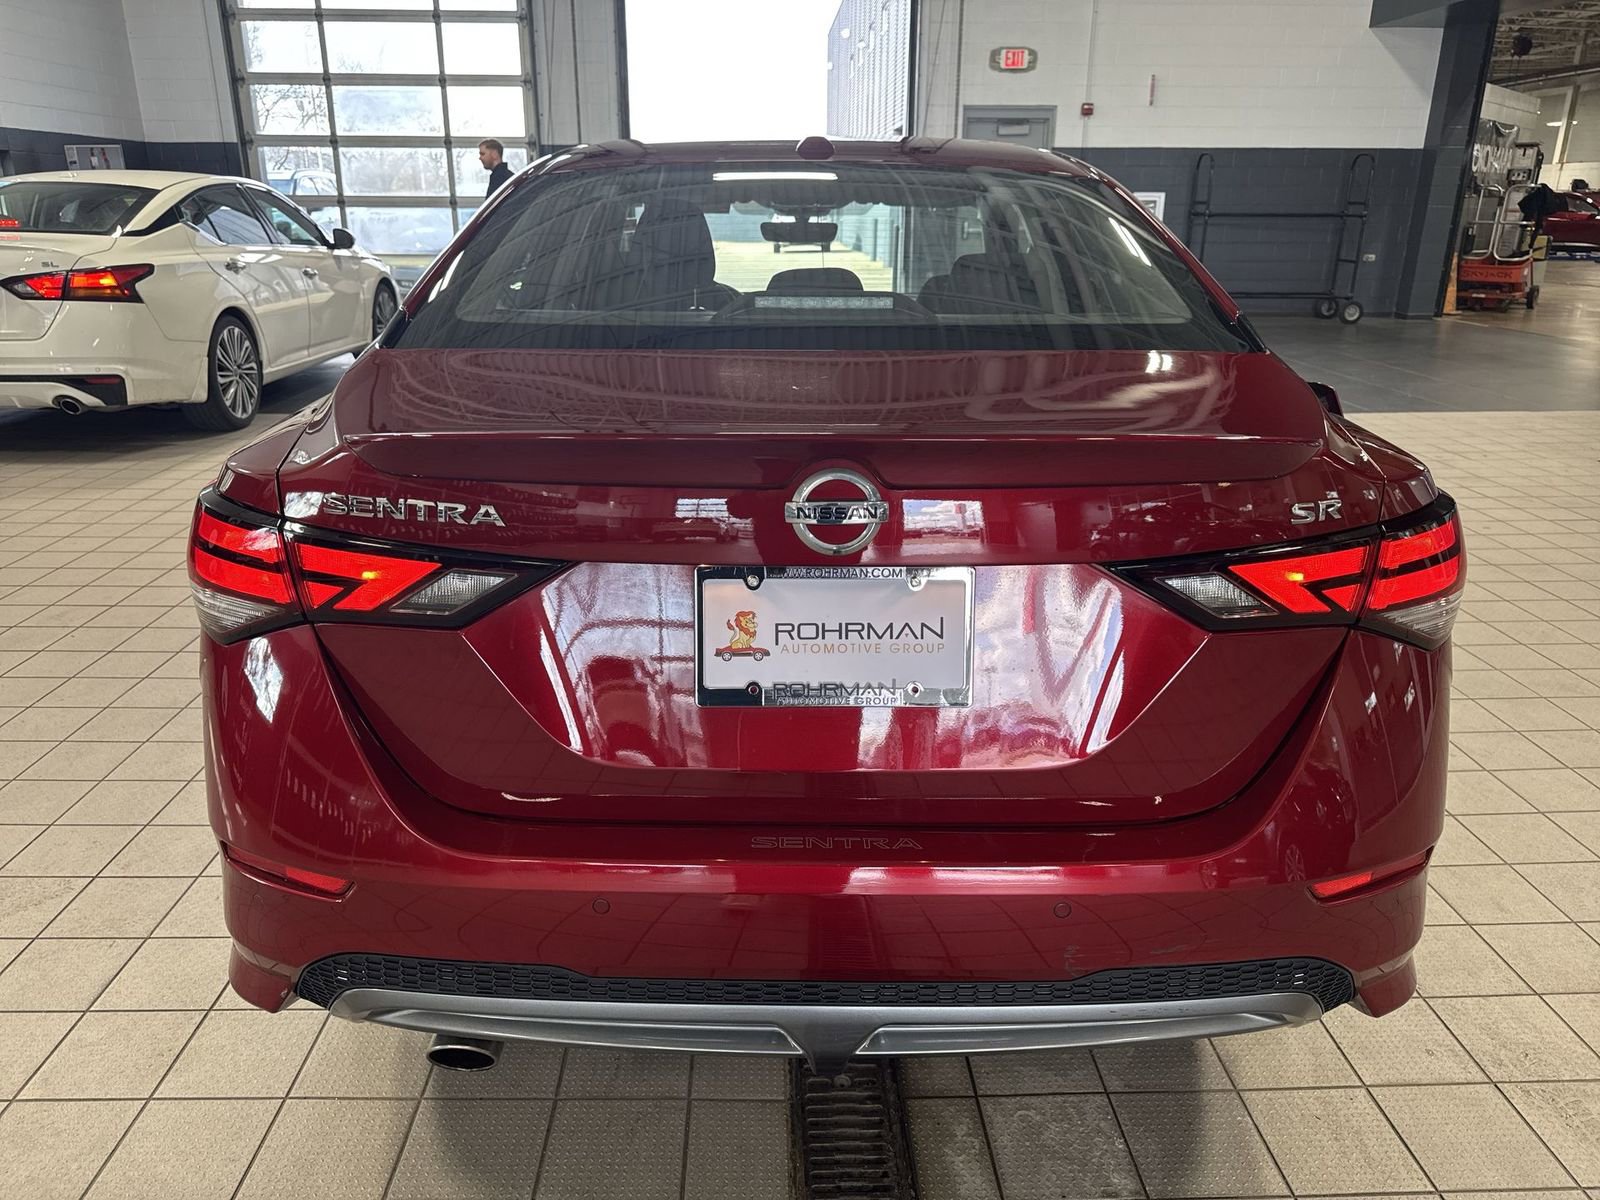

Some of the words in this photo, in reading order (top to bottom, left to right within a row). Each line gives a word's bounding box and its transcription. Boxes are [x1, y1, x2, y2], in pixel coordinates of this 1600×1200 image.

[1005, 50, 1025, 67] EXIT
[321, 491, 506, 527] SENTRA
[796, 506, 878, 520] NISSAN
[1291, 499, 1342, 524] SR
[775, 617, 944, 645] ROHRMAN
[780, 643, 881, 654] AUTOMOTIVE
[891, 642, 944, 653] GROUP
[773, 678, 896, 700] ROHRMAN
[856, 696, 896, 705] GROUP
[751, 837, 923, 849] SENTRA
